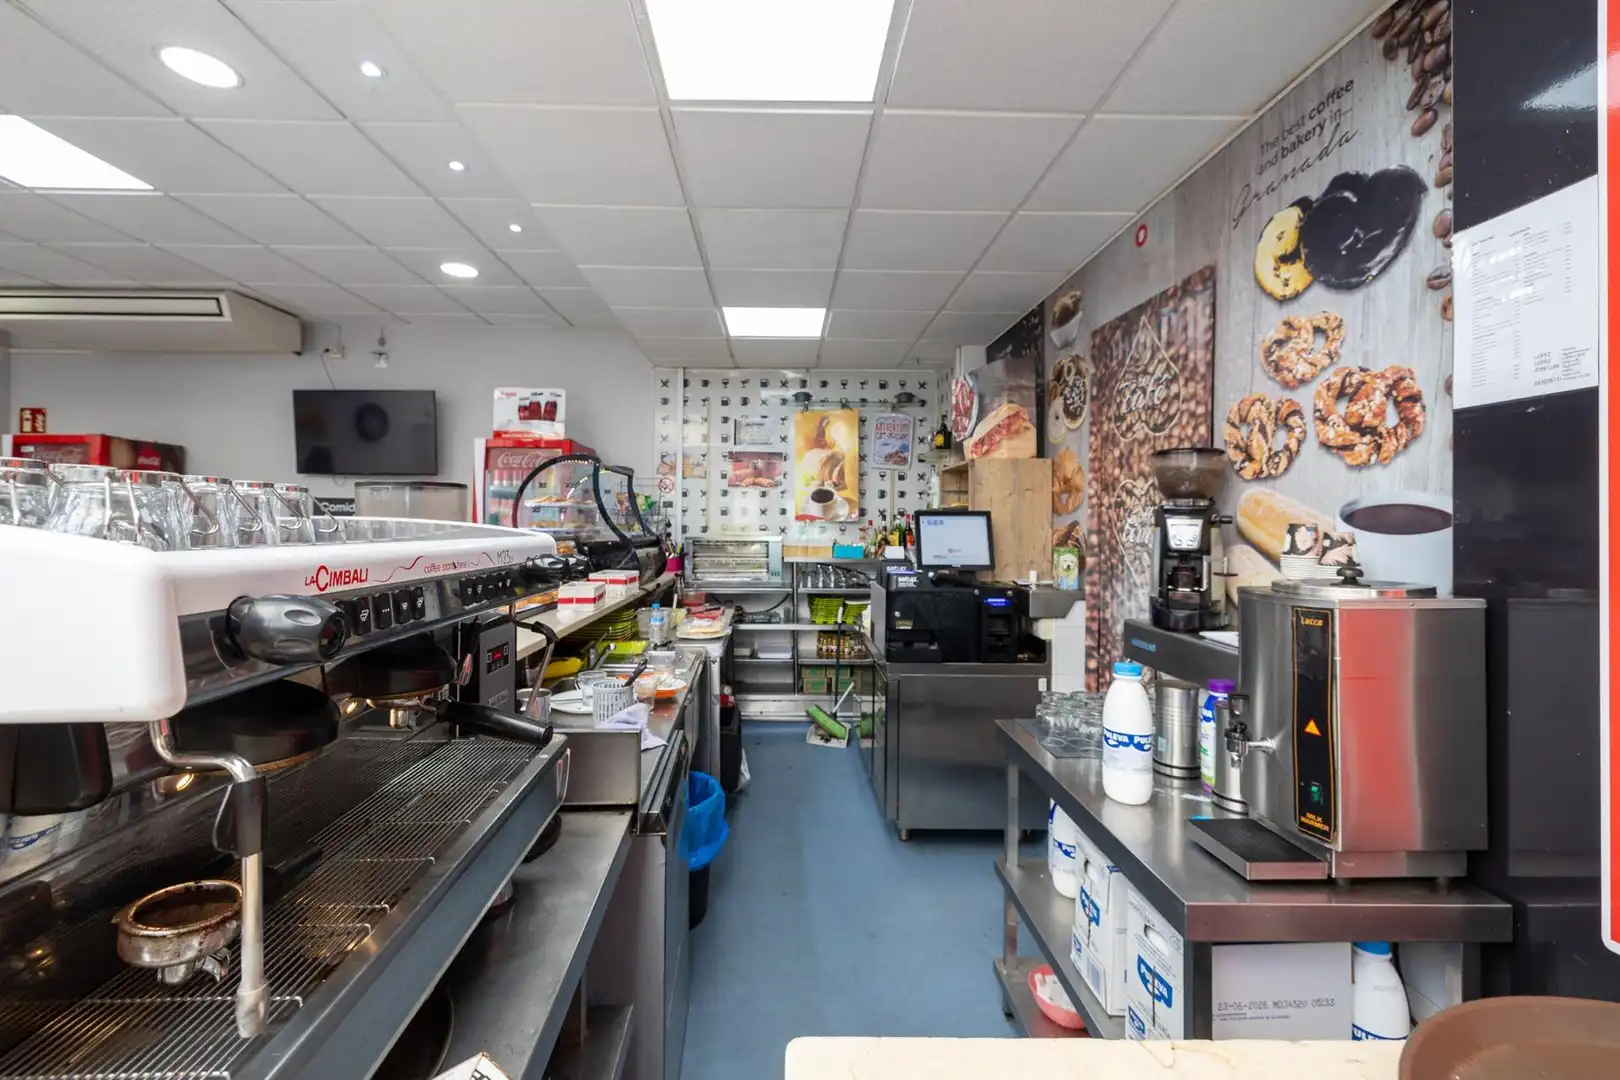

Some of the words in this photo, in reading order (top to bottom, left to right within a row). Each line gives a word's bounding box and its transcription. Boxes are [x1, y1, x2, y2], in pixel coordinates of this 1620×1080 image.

[1260, 134, 1280, 156] The
[1282, 114, 1306, 141] best
[1308, 79, 1355, 121] coffee
[1281, 116, 1328, 159] bakery
[304, 575, 317, 586] LA
[316, 565, 369, 592] CIMBALI
